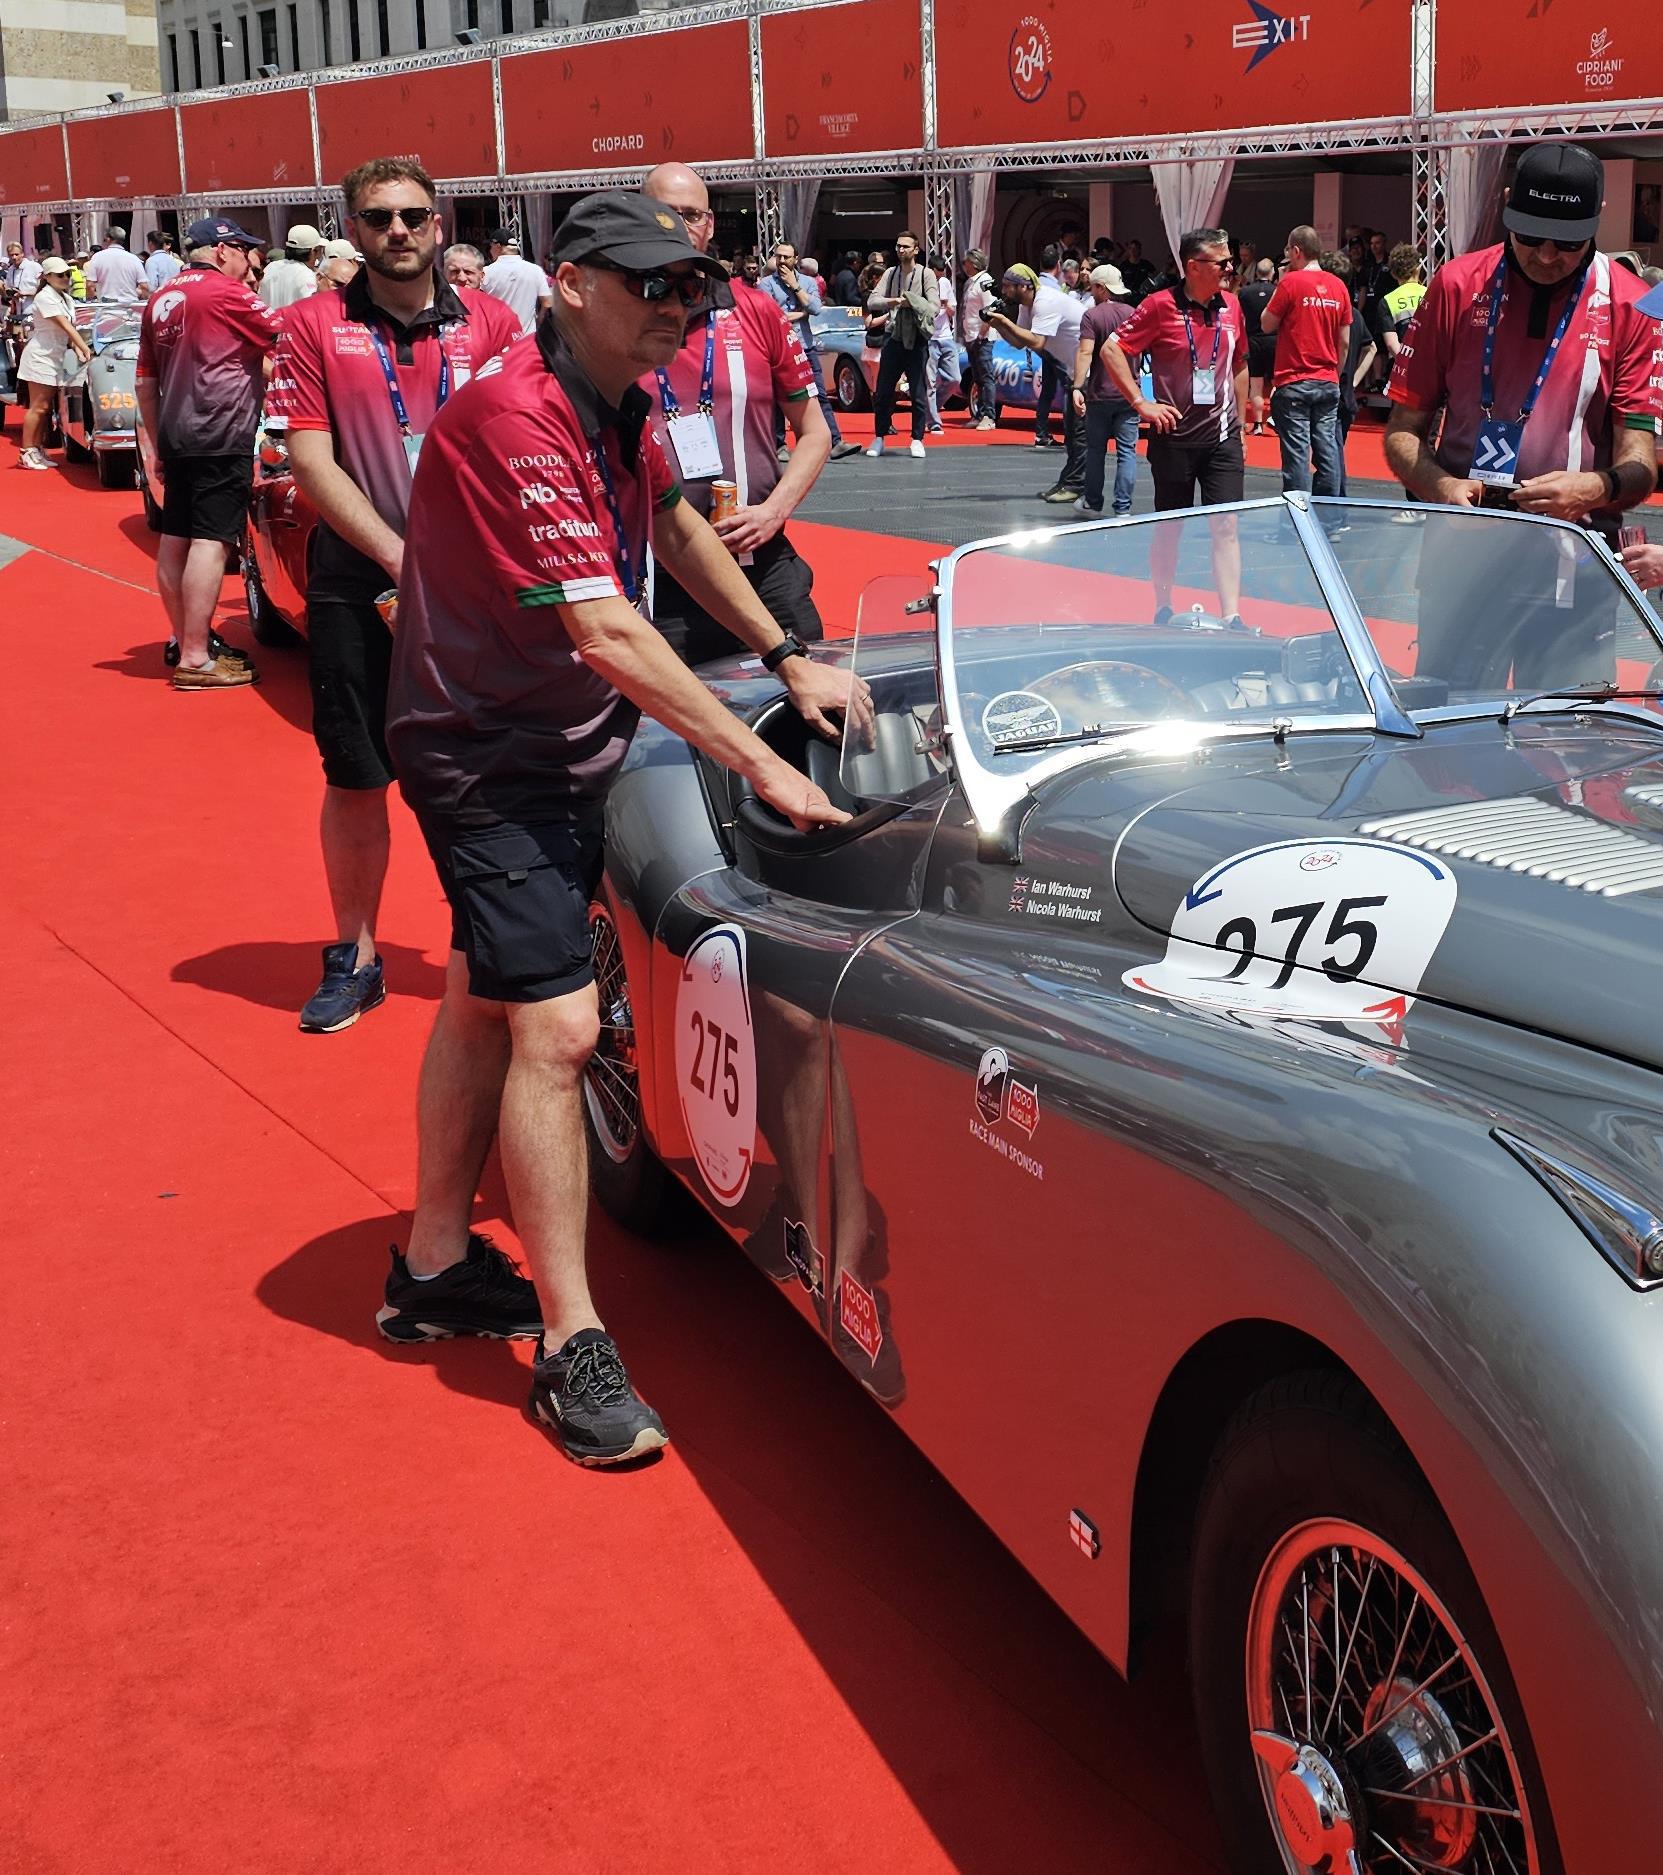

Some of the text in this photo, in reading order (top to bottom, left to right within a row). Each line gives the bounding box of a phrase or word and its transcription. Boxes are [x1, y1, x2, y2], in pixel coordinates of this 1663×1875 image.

[1021, 16, 1053, 63] 1000 MIGLIA
[1233, 15, 1310, 48] EXIT
[1015, 36, 1045, 81] 2024
[1577, 60, 1622, 74] CIPRIANI
[1585, 73, 1613, 86] FOOD
[592, 134, 644, 152] CHOPARD
[1529, 189, 1581, 203] ELECTRA
[98, 393, 135, 410] 325
[519, 483, 557, 510] pib
[537, 553, 577, 569] MILLS
[997, 723, 1057, 742] JAGUAR
[1031, 880, 1091, 900] Ian Warhurst
[1026, 900, 1101, 922] Nicola Warhurst
[1187, 896, 1388, 990] 275
[690, 1010, 739, 1118] 275
[1013, 1087, 1032, 1109] 1000
[1010, 1104, 1032, 1127] MIGLIA
[969, 1118, 1044, 1180] RACE MAIN SPONSOR
[846, 1280, 870, 1319] 1000
[844, 1305, 873, 1347] MIGLIA
